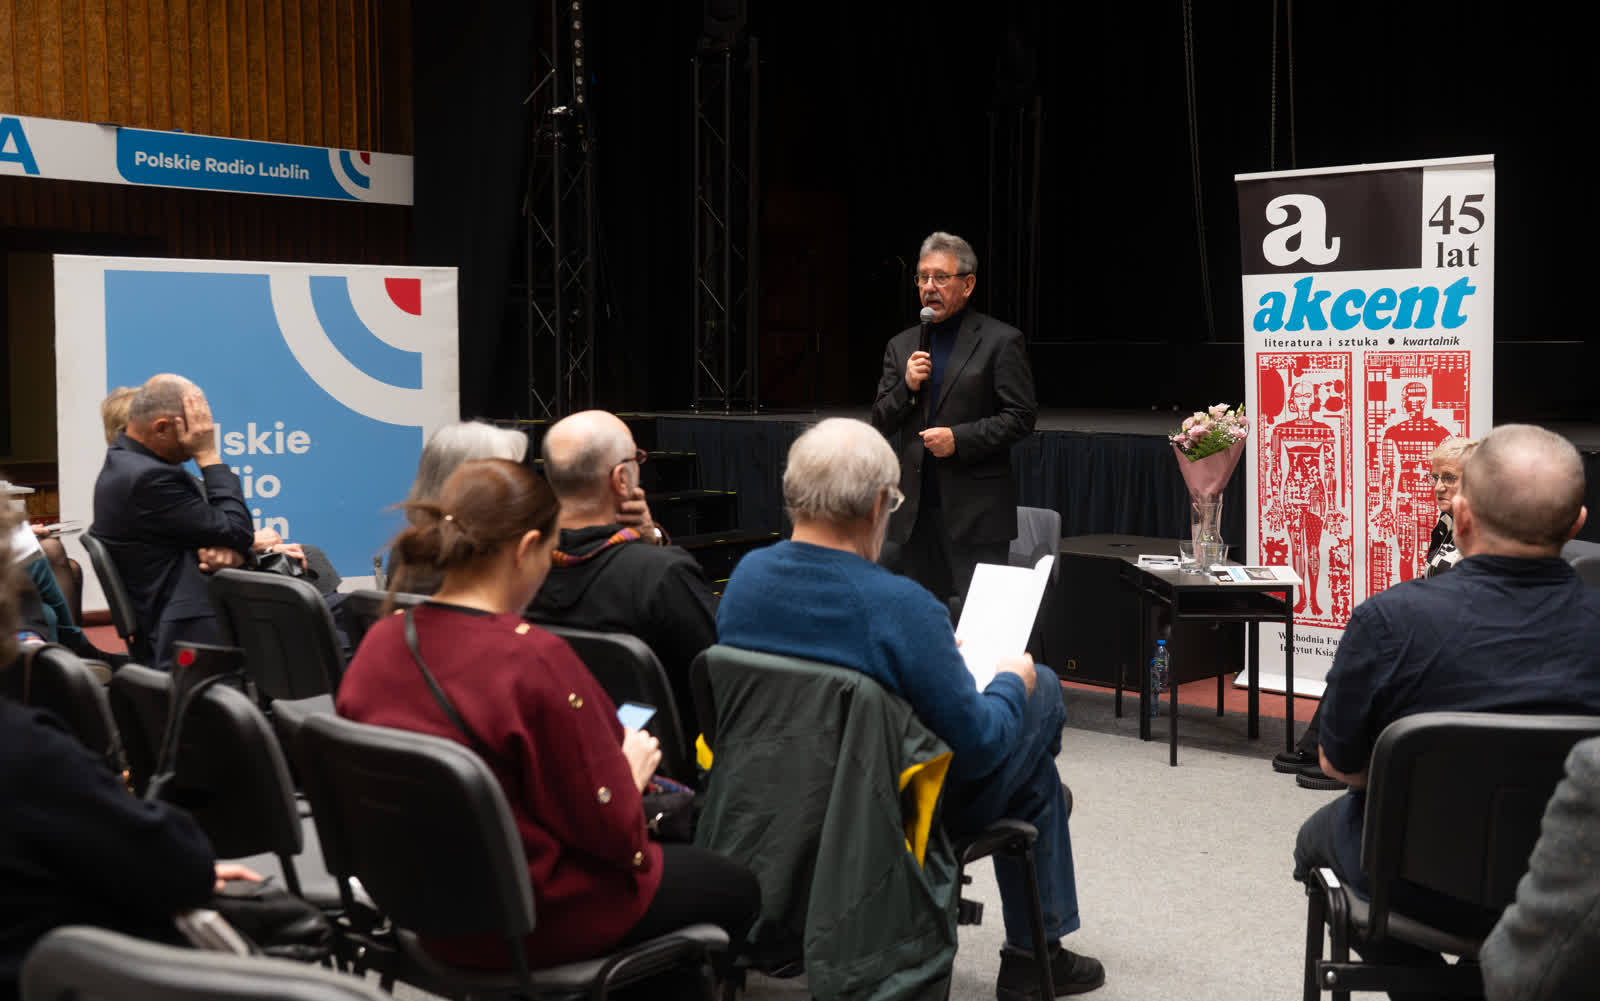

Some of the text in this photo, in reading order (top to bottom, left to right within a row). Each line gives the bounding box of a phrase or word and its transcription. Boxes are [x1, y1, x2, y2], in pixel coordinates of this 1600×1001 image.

[135, 151, 310, 180] Polskie Radio Lublin
[1428, 193, 1485, 235] 45
[1262, 193, 1340, 267] a
[1436, 241, 1480, 268] lat
[1252, 275, 1477, 332] akcent
[1264, 338, 1322, 347] literatura
[1338, 337, 1379, 346] sztuka
[1402, 335, 1460, 346] kwartalnik
[213, 421, 311, 455] lskie
[1278, 632, 1324, 644] Whodnia
[1280, 643, 1313, 655] Iytut
